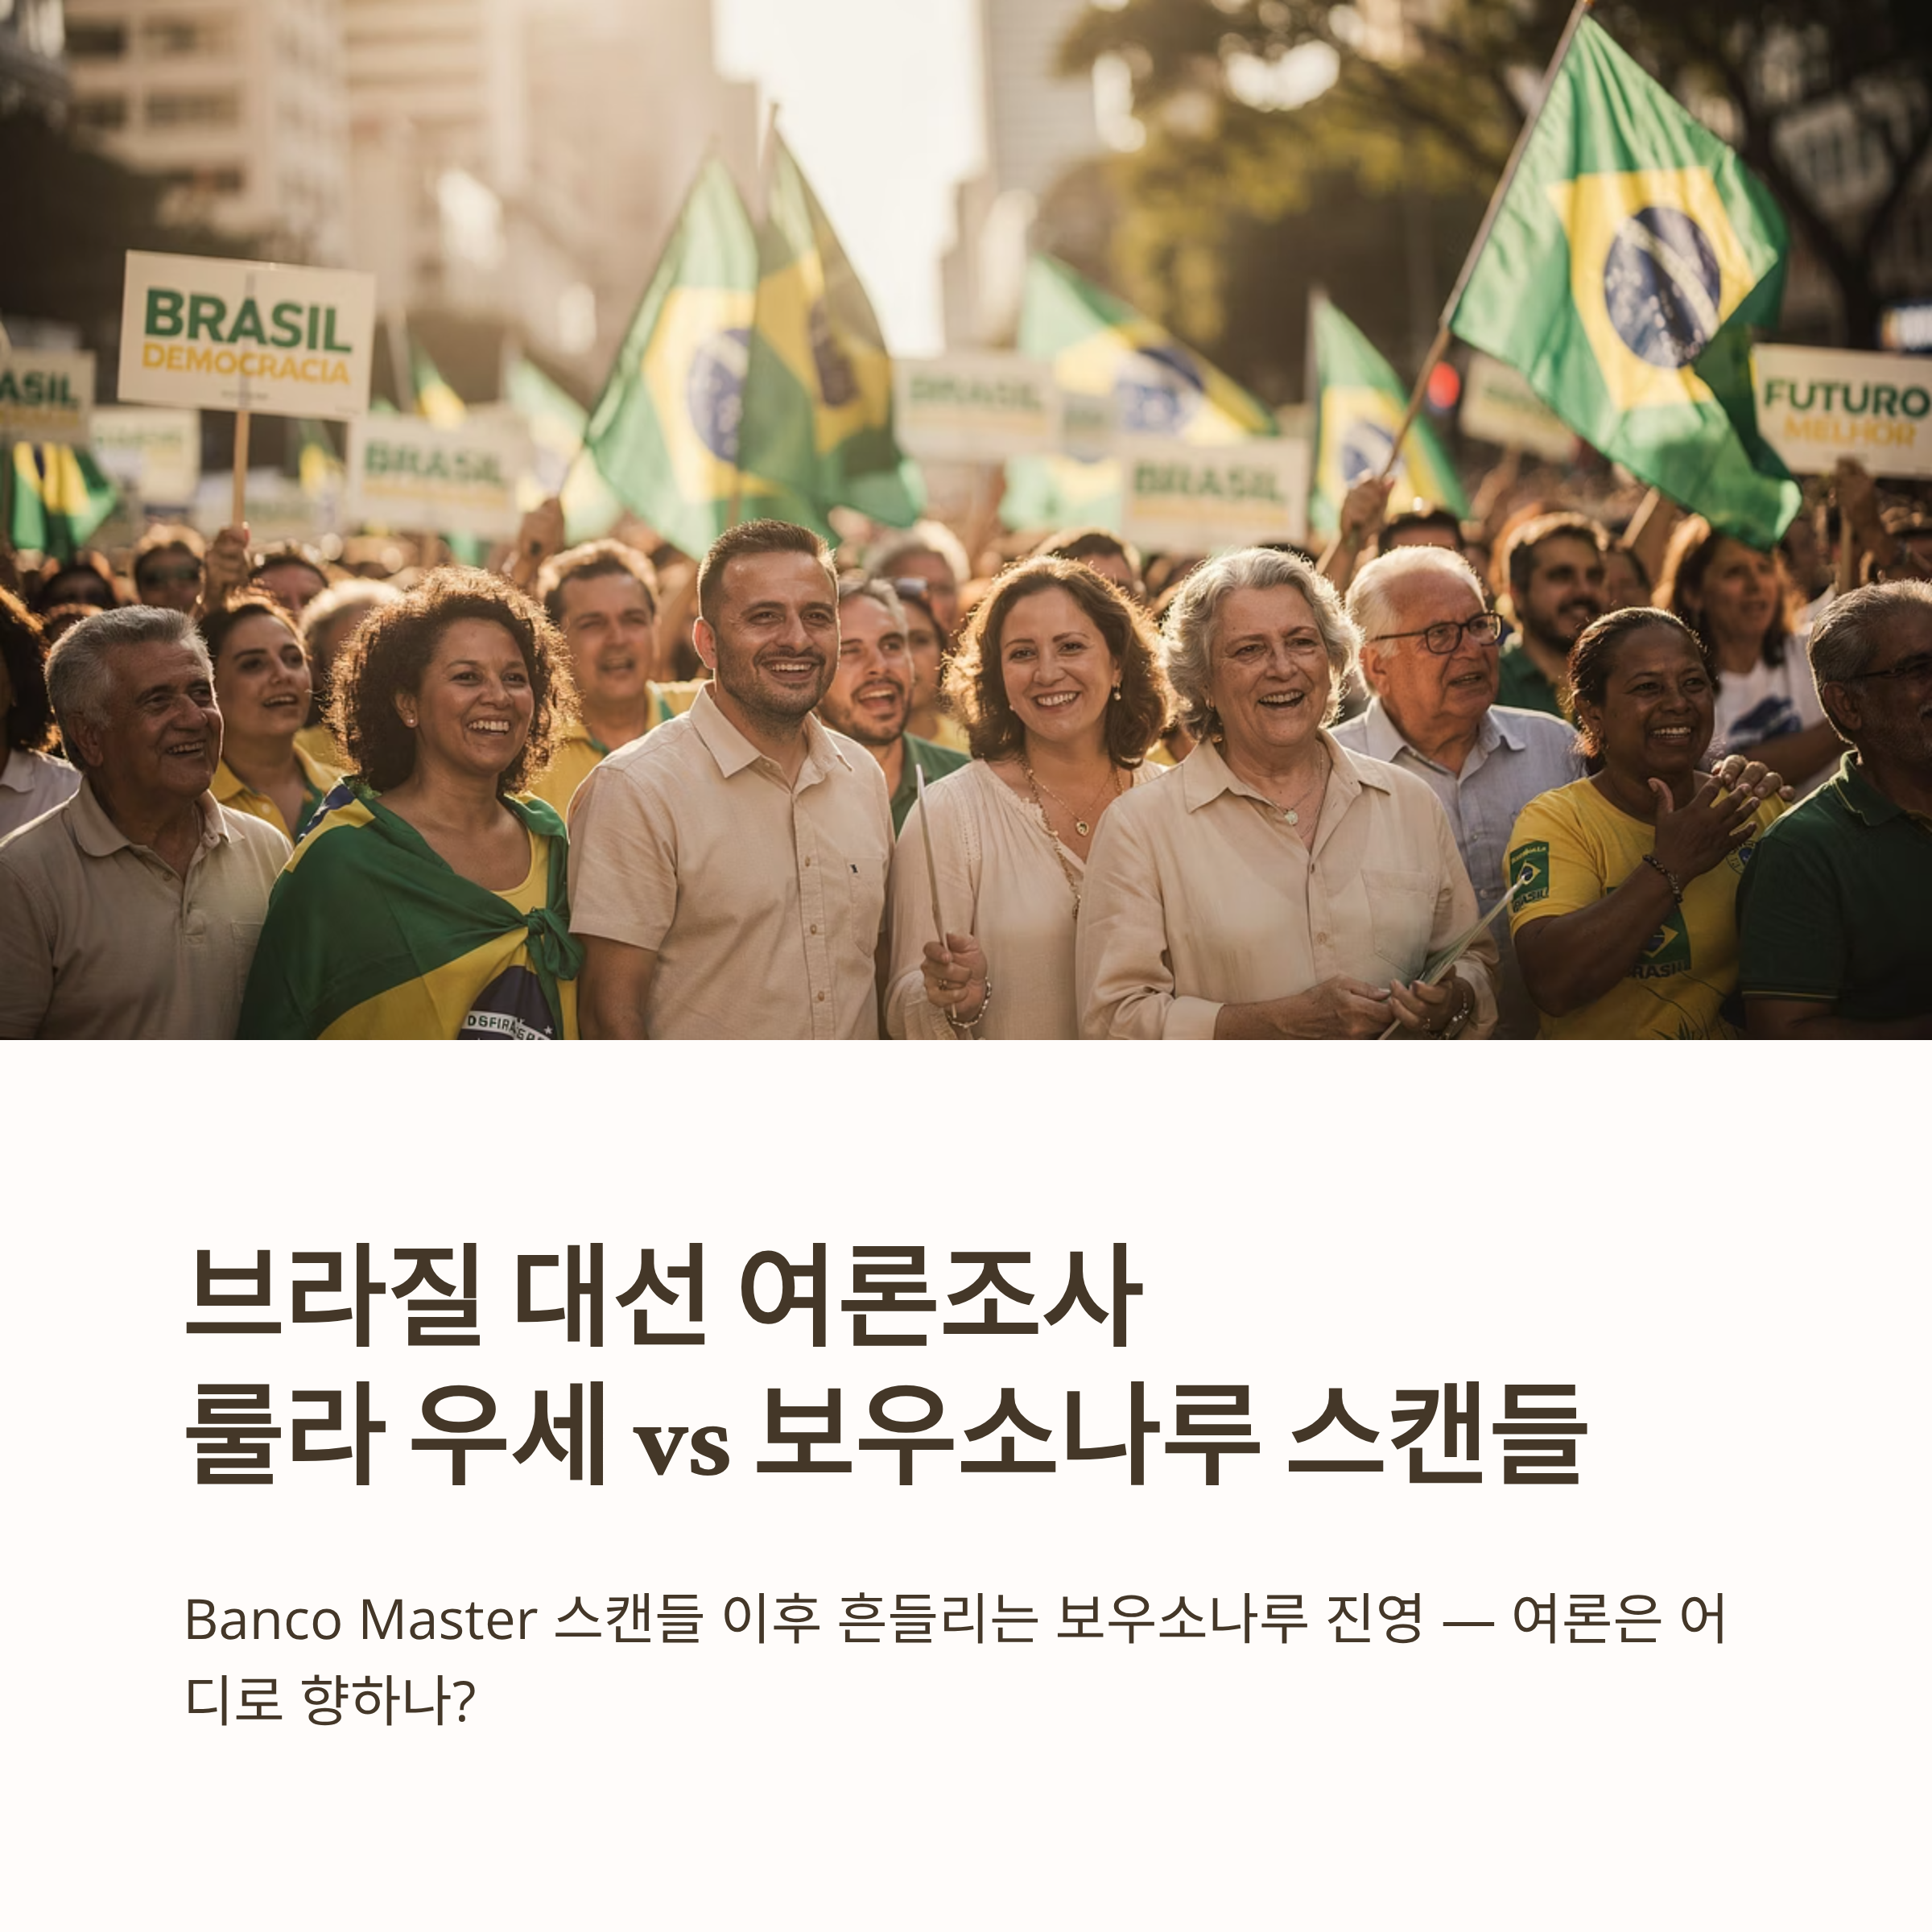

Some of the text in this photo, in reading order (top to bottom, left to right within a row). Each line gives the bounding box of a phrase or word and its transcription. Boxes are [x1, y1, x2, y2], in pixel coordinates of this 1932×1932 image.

[144, 287, 352, 353] BRASIL
[142, 341, 351, 386] DEMOCRACIA
[1765, 378, 1930, 419] FUTURO
[1784, 412, 1917, 448] MELHOR
